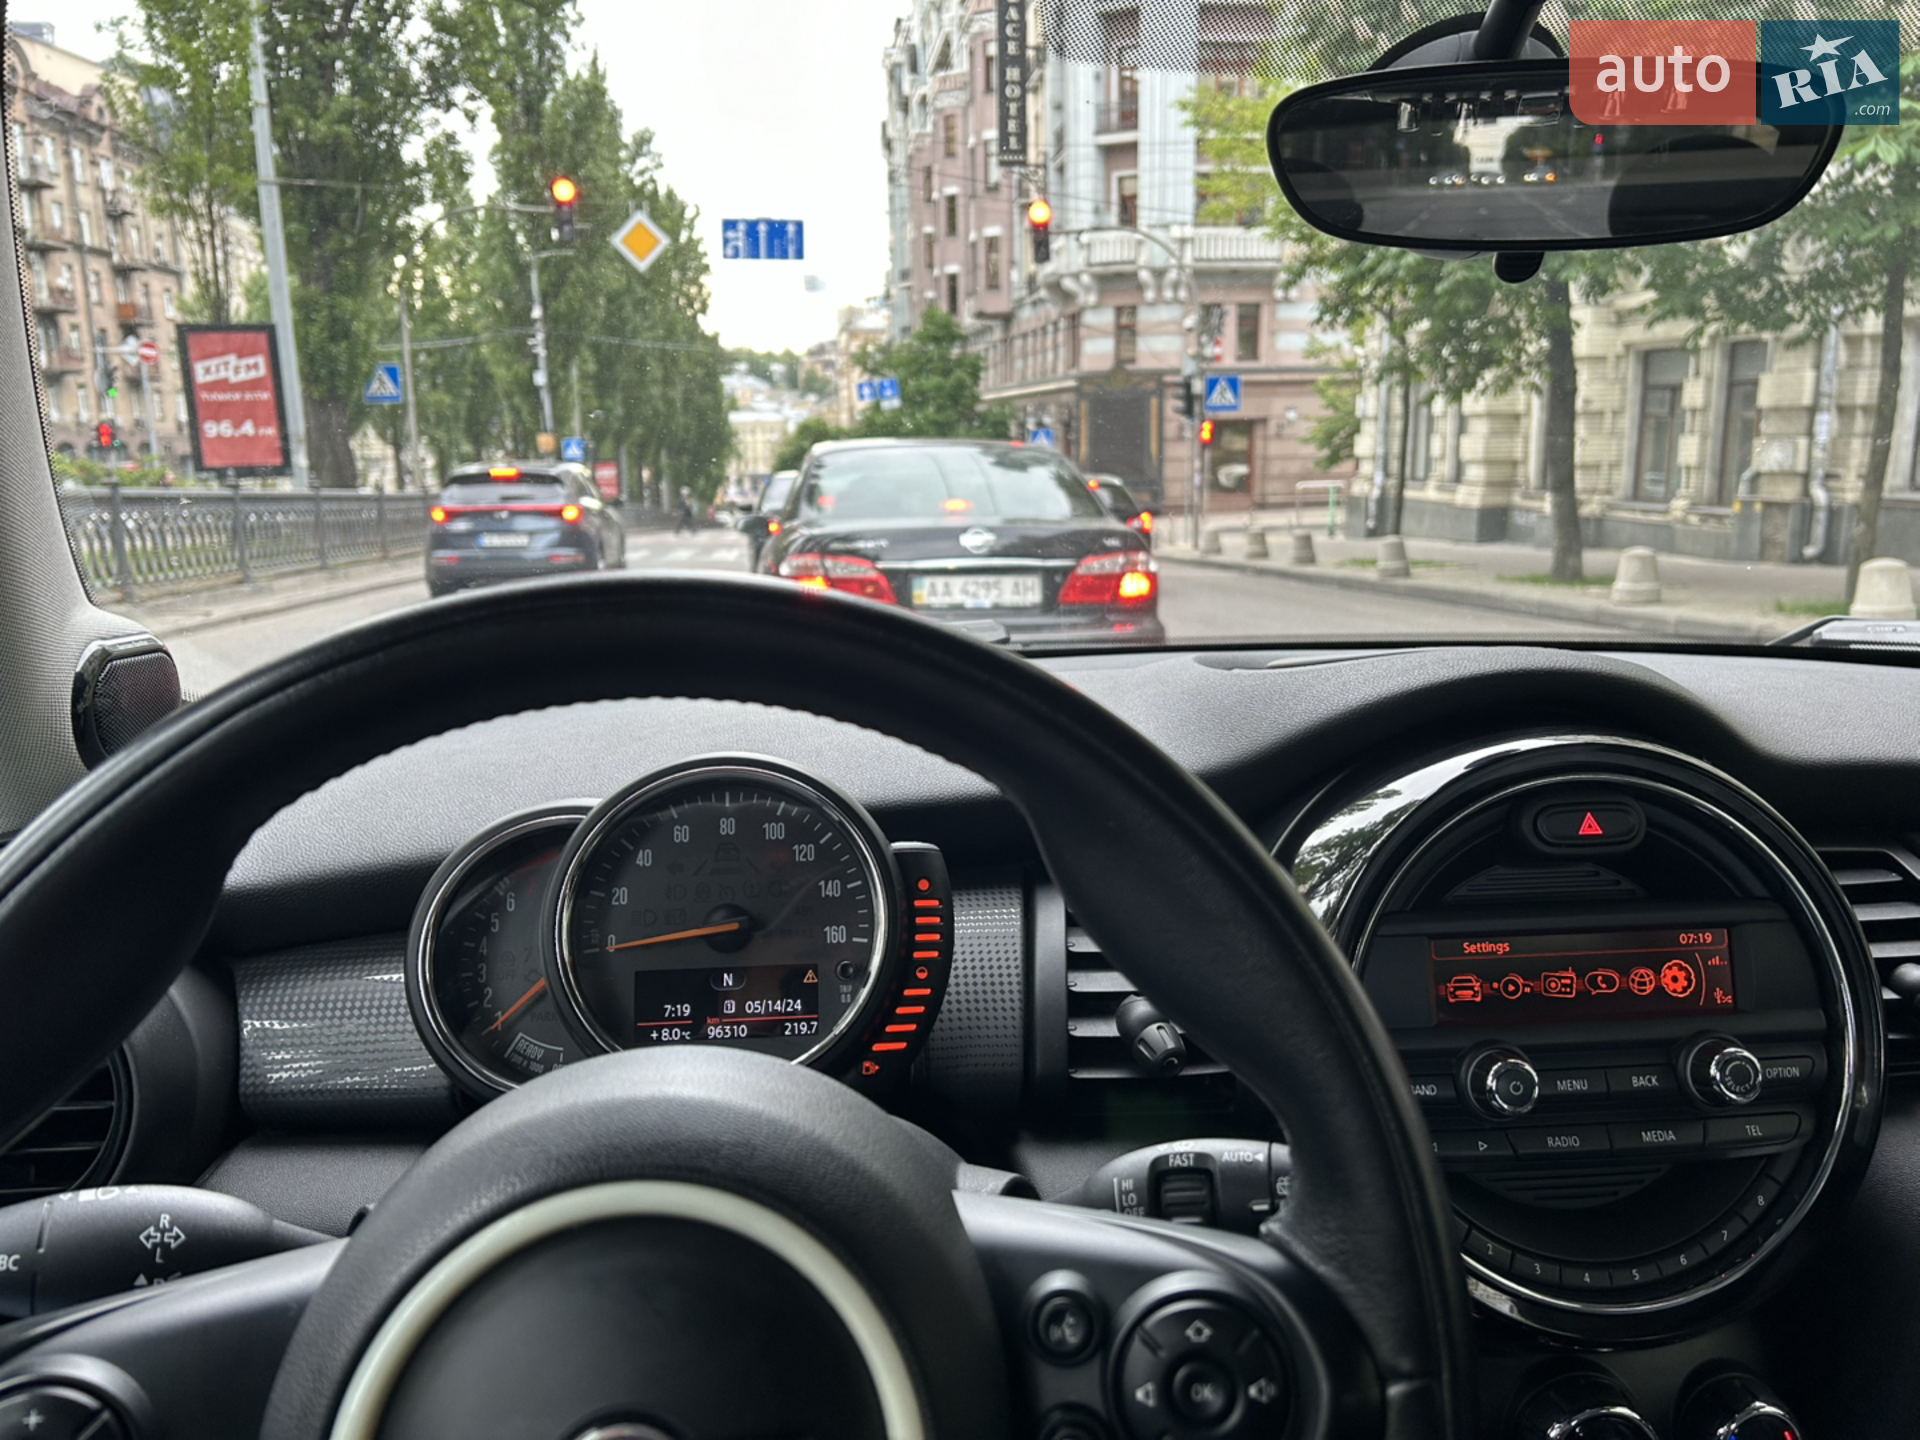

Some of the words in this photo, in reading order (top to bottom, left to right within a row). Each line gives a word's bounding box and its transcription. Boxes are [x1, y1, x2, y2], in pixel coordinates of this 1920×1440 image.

[1005, 0, 1021, 55] ACE
[1005, 67, 1021, 149] HOTEL
[203, 419, 256, 438] 96.4
[926, 577, 954, 599] AA
[960, 577, 1001, 598] 4295
[1011, 576, 1036, 596] AH
[673, 825, 690, 843] 60
[719, 817, 735, 836] 80
[763, 822, 785, 840] 100
[636, 849, 652, 867] 40
[792, 844, 815, 862] 120
[818, 879, 841, 897] 140
[506, 892, 516, 912] 6
[611, 887, 628, 905] 20
[490, 912, 500, 933] 5
[823, 925, 847, 943] 160
[1679, 932, 1713, 944] 07:19
[479, 936, 488, 956] 4
[607, 934, 616, 952] 0
[1462, 941, 1510, 955] Settings
[477, 963, 487, 983] 3
[723, 973, 734, 987] N
[483, 987, 493, 1008] 2
[664, 1004, 691, 1017] 7:19
[745, 998, 802, 1014] 05/14/24
[706, 1016, 720, 1024] km
[707, 1024, 748, 1039] 96310
[784, 1021, 819, 1036] 219.7
[515, 1039, 545, 1061] READY
[1766, 1066, 1800, 1080] OPTION
[1556, 1079, 1589, 1092] MENU
[1631, 1074, 1659, 1089] BACK
[1724, 1076, 1751, 1093] SELECT
[1641, 1129, 1676, 1143] MEDIA
[1745, 1123, 1763, 1137] TEL
[1547, 1134, 1580, 1149] RADIO
[1168, 1153, 1195, 1168] FAST
[1221, 1152, 1253, 1164] AUTO
[1121, 1178, 1134, 1192] HI
[1122, 1193, 1137, 1206] LO
[1757, 1195, 1764, 1206] 8
[159, 1213, 170, 1228] R
[1721, 1230, 1728, 1241] 7
[155, 1247, 164, 1264] L
[1486, 1243, 1494, 1255] 2
[1679, 1254, 1687, 1266] 6
[1534, 1262, 1541, 1275] 3
[1632, 1269, 1640, 1281] 5
[1583, 1271, 1590, 1283] 4
[1190, 1382, 1213, 1402] OK
